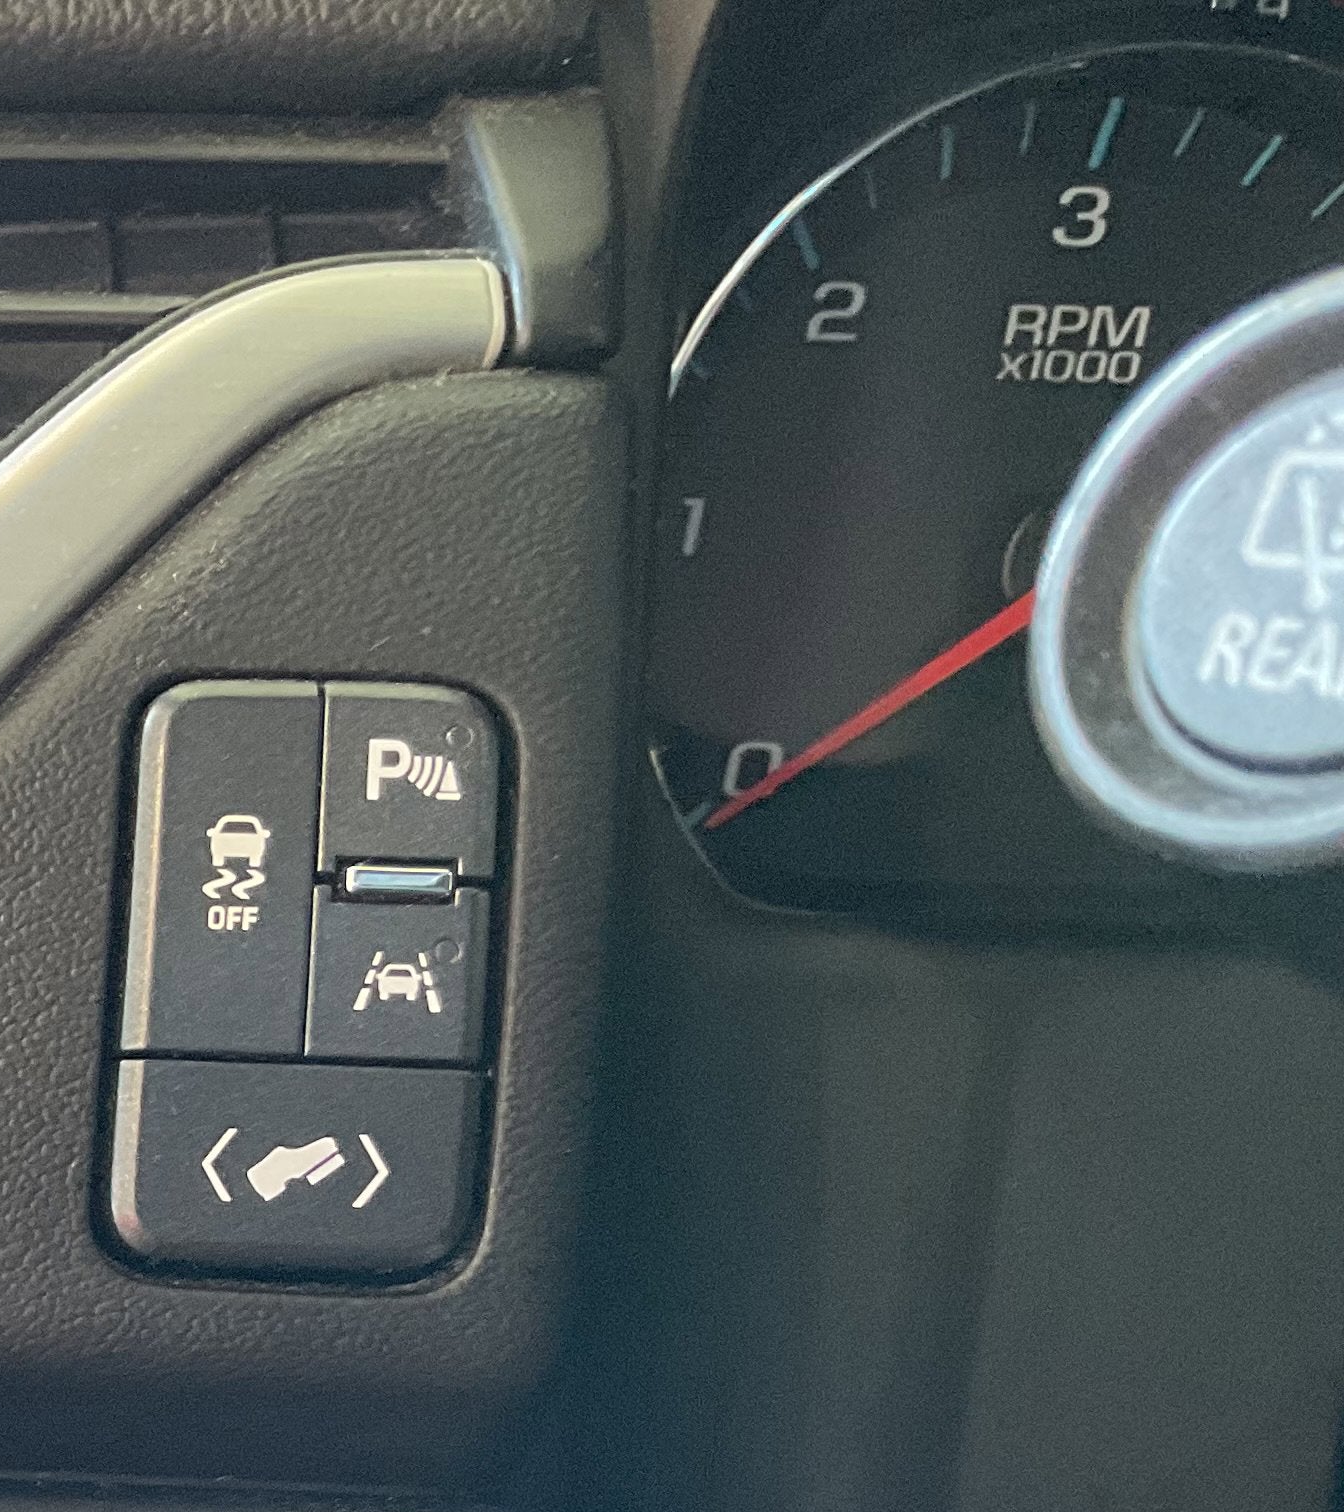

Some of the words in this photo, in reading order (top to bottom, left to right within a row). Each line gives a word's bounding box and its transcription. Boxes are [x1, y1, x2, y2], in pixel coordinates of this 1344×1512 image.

[1051, 186, 1110, 249] 3
[805, 281, 867, 343] 2
[1002, 303, 1152, 348] RPM
[996, 350, 1142, 385] x1000
[681, 497, 707, 556] 1
[1197, 610, 1344, 698] REA
[366, 738, 412, 801] P
[723, 740, 784, 799] 0
[207, 905, 261, 932] OFF
